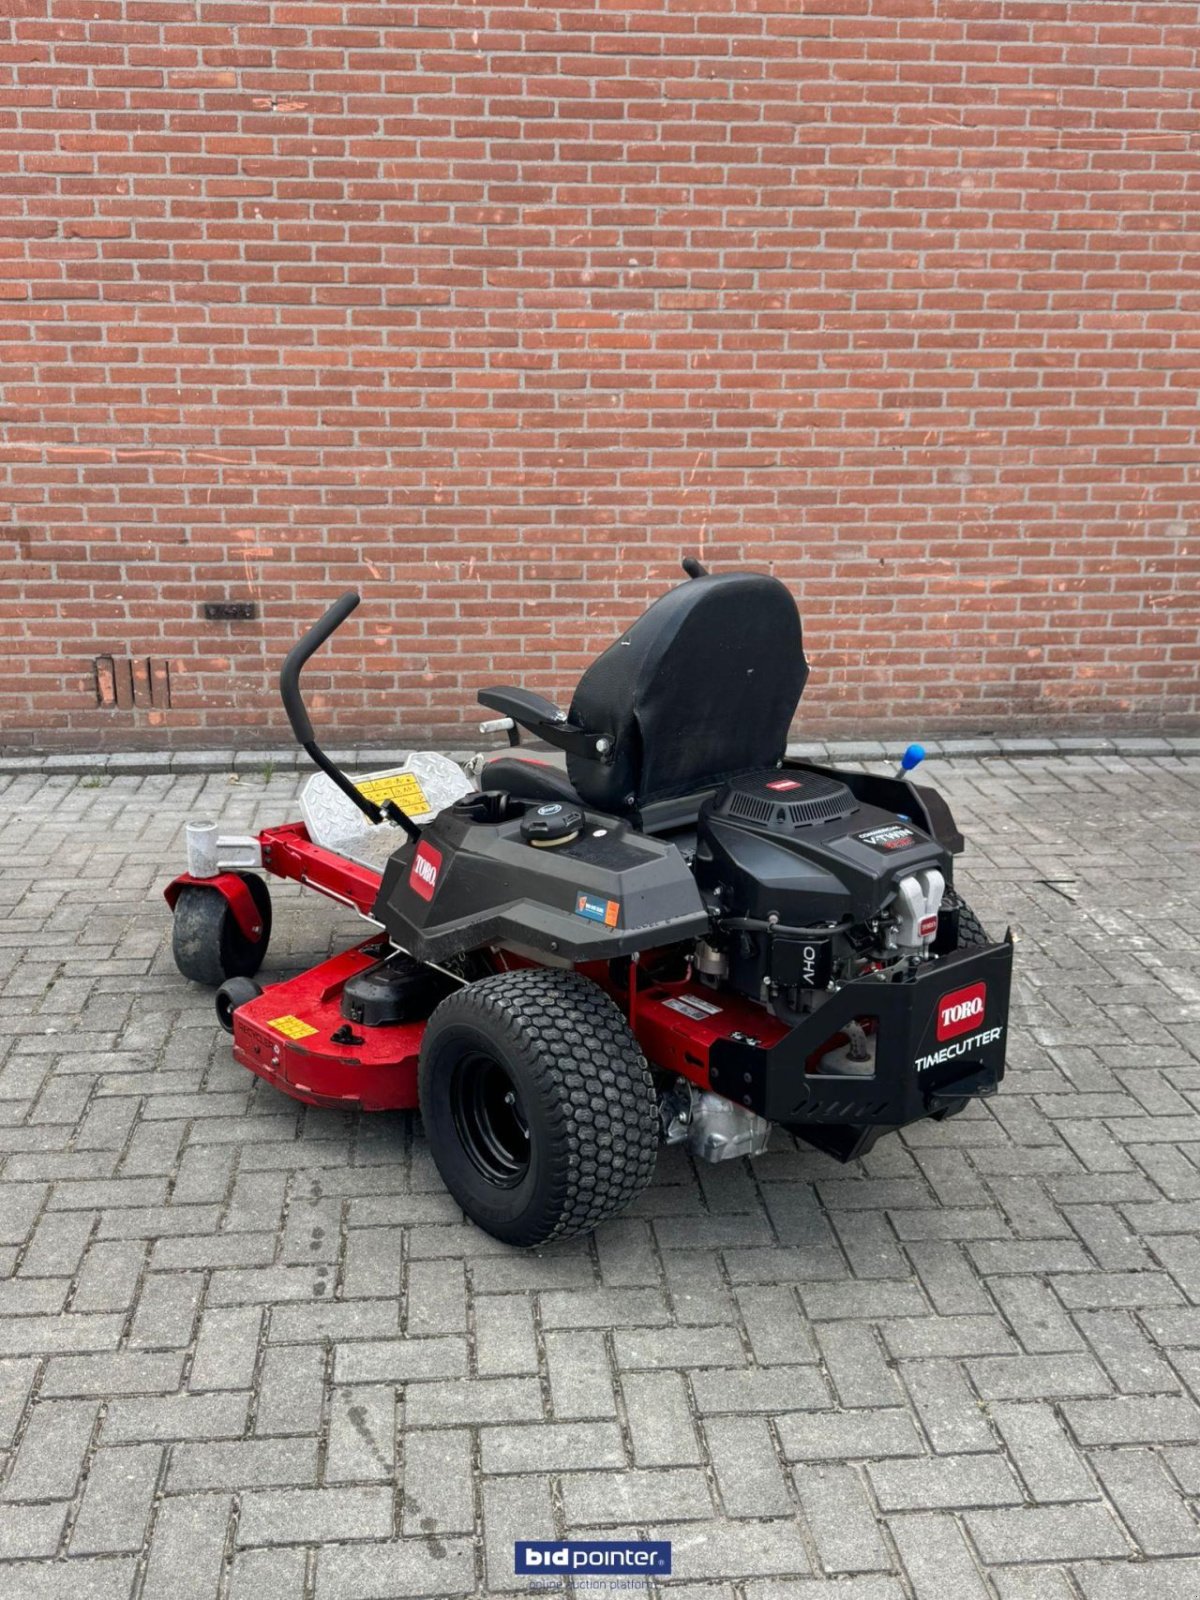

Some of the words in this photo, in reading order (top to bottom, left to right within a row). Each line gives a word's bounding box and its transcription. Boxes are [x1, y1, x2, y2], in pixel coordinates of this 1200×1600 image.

[414, 854, 437, 886] TORO
[803, 946, 815, 985] OHV
[941, 997, 983, 1026] TORO
[914, 1027, 1002, 1072] TIMECUTTER
